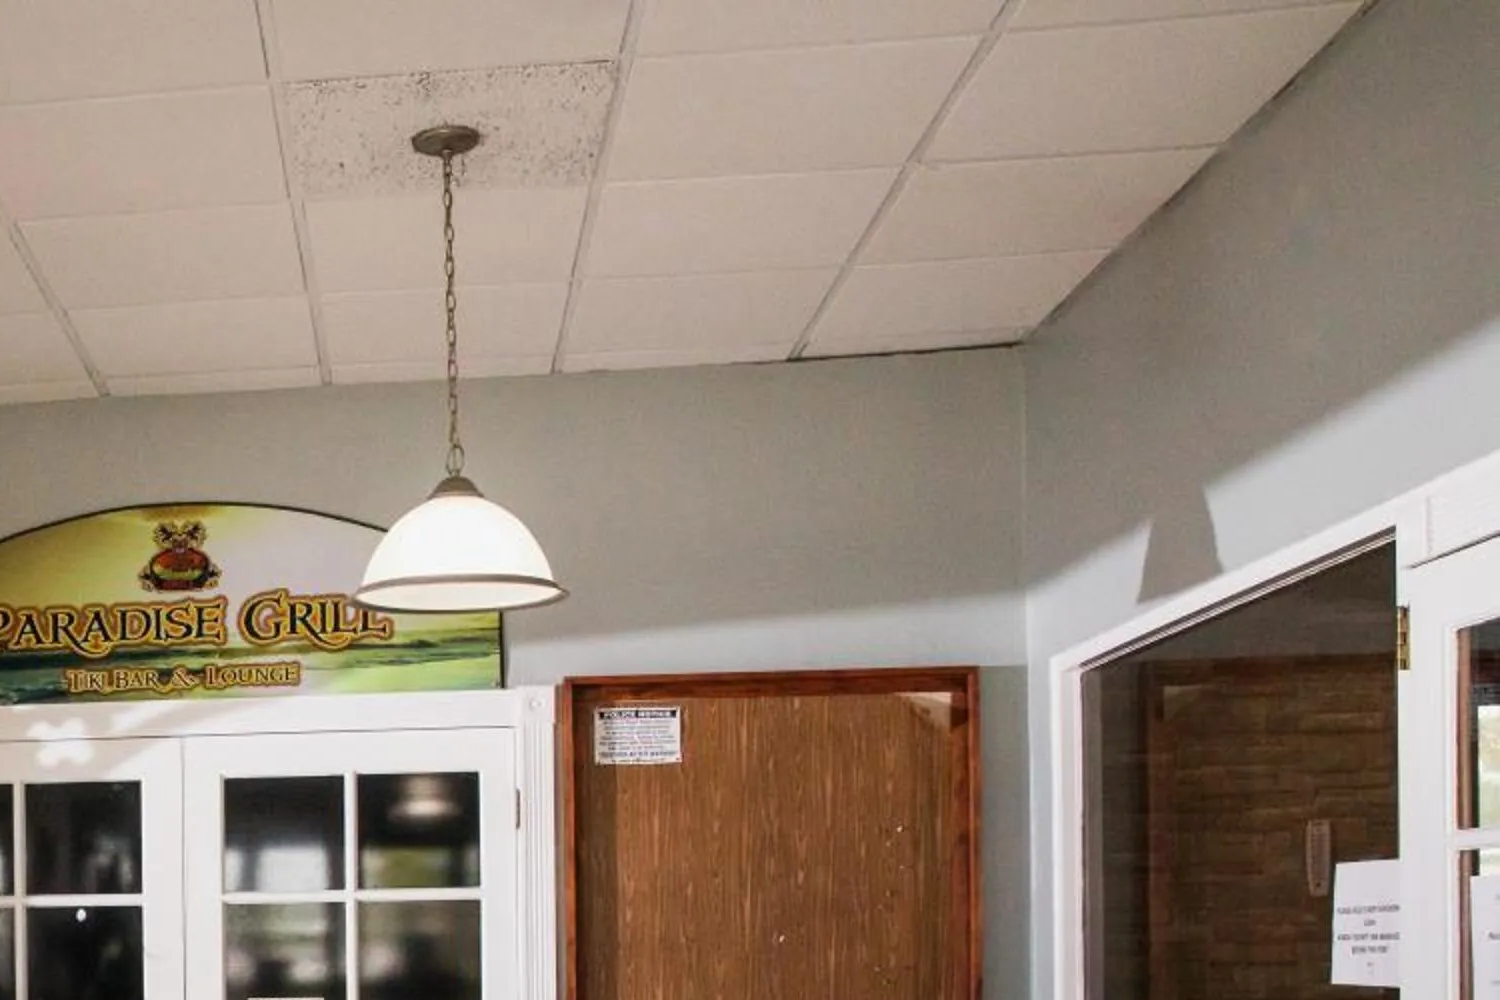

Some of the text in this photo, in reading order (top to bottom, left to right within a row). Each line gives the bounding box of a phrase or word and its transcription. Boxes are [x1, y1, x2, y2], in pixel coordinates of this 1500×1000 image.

[243, 592, 389, 648] GRILL
[113, 667, 167, 692] BAR
[170, 665, 198, 690] &
[206, 664, 298, 688] LOUNGE
